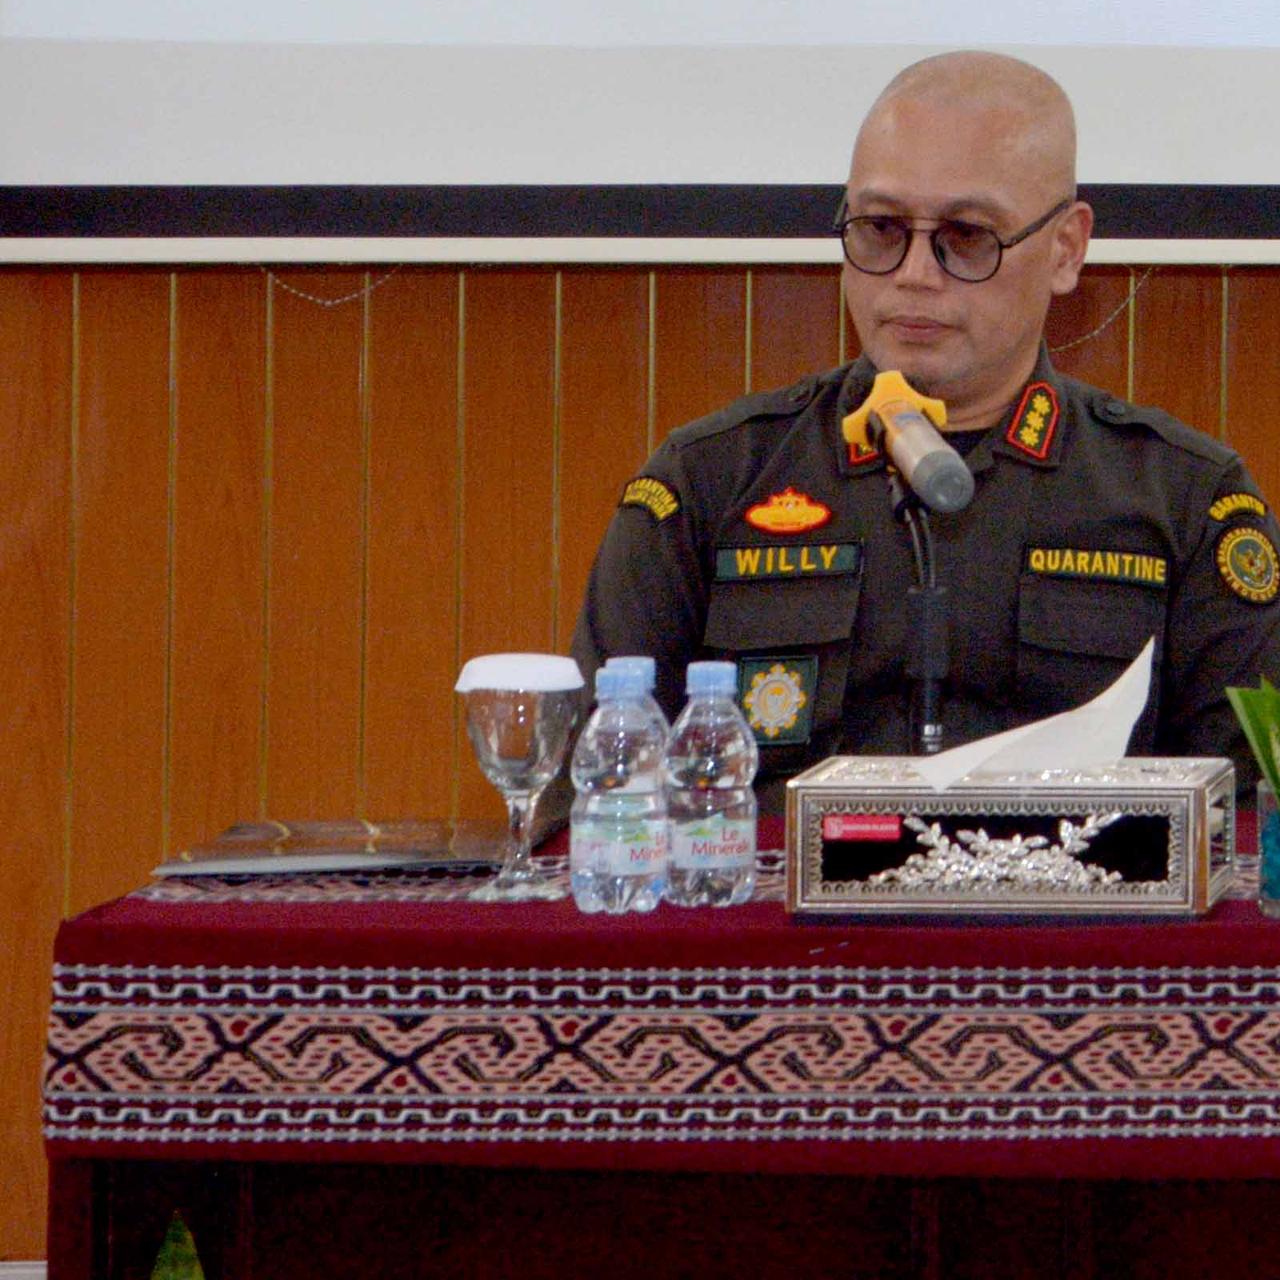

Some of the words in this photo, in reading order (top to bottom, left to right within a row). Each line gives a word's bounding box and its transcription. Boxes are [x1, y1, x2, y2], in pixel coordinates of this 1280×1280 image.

[735, 545, 838, 575] WILLY
[1029, 548, 1167, 583] QUARANTINE
[720, 827, 739, 842] Le
